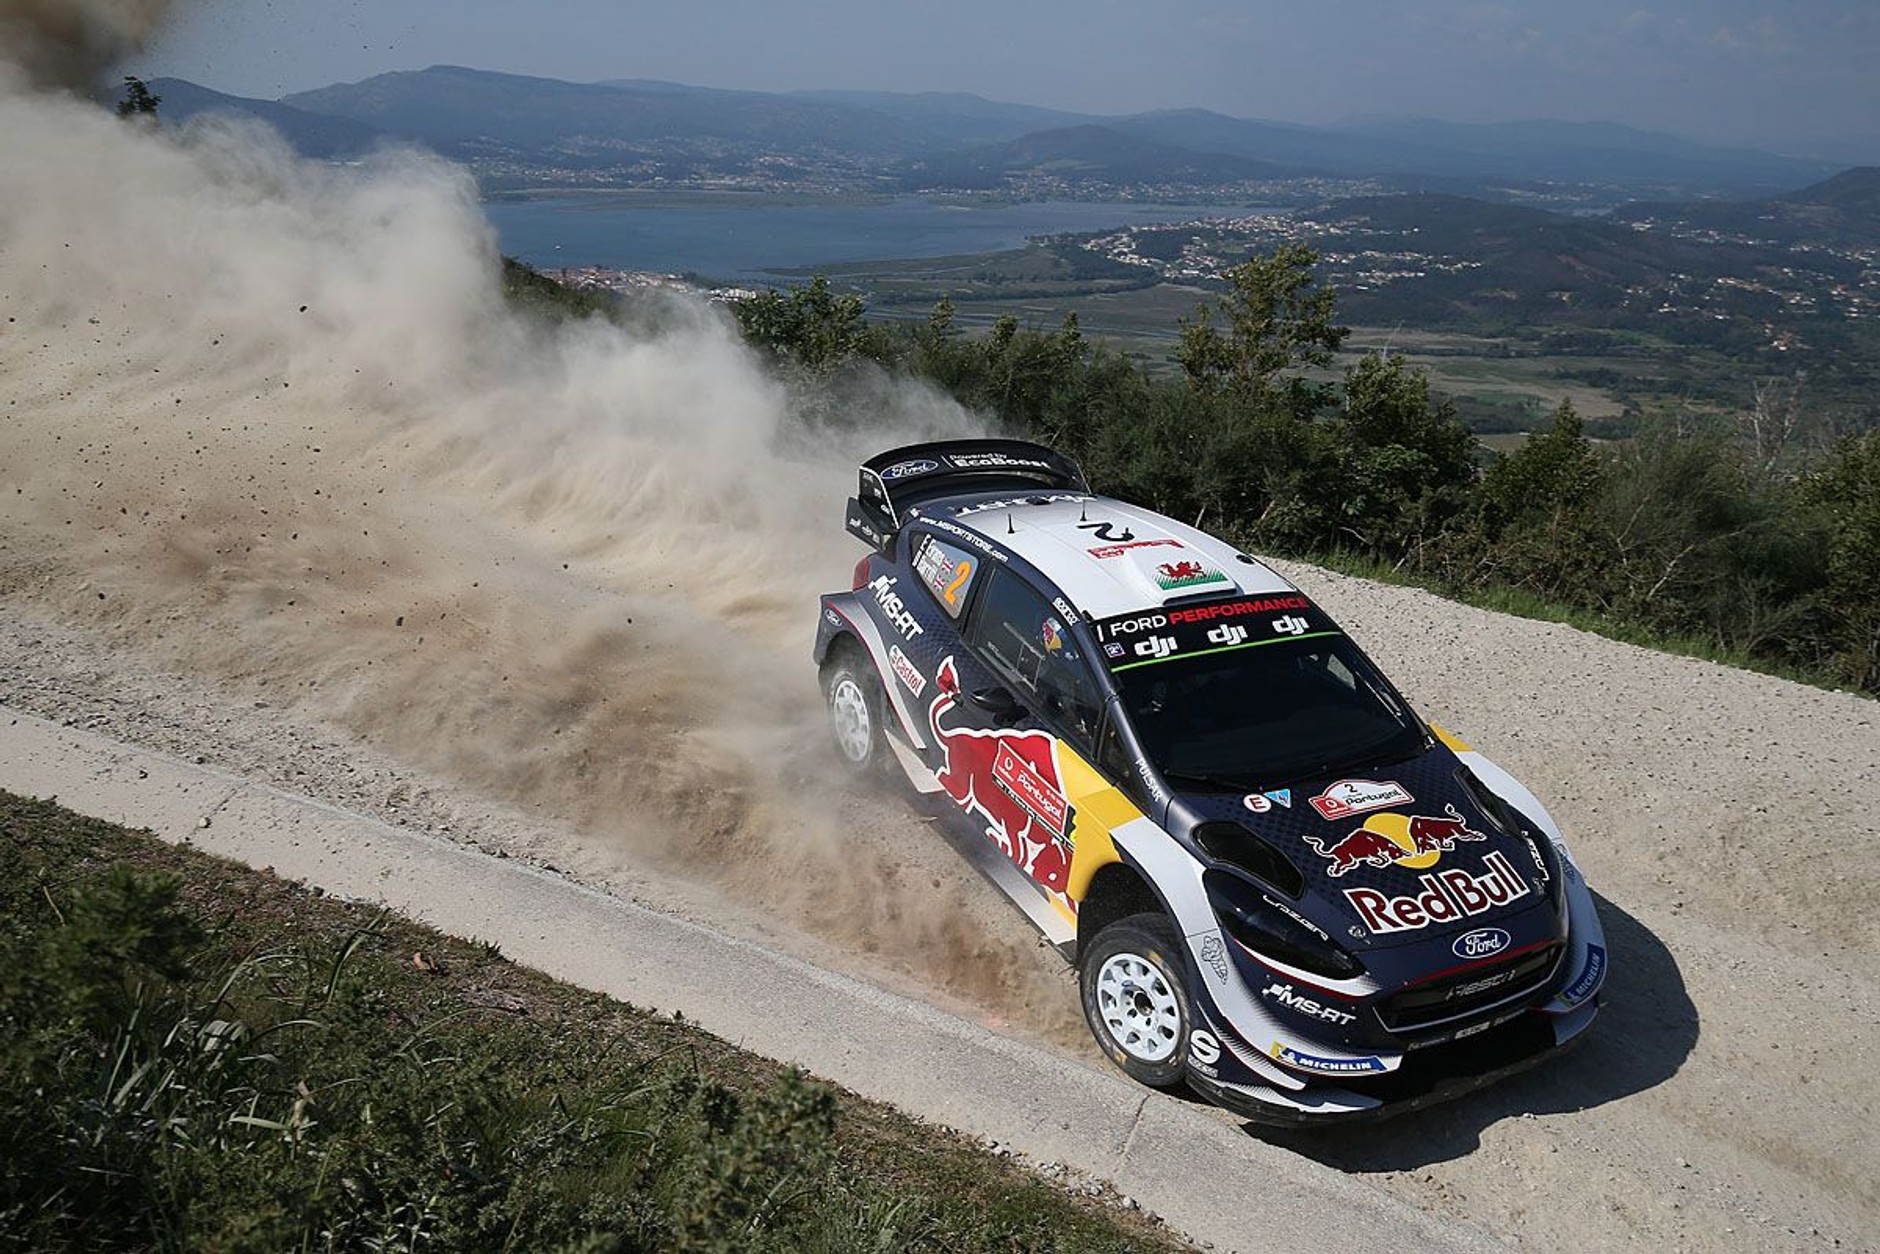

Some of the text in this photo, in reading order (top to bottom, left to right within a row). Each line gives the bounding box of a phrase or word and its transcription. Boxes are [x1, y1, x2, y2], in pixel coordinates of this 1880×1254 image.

[890, 462, 931, 478] Ford
[944, 561, 972, 605] 2
[1109, 597, 1309, 637] FORD PERFORMANCE
[1134, 635, 1178, 658] dji
[1207, 624, 1248, 645] dji
[1271, 614, 1310, 635] dji
[895, 656, 923, 694] Castrol
[1017, 773, 1063, 821] Portugal
[1134, 758, 1165, 802] PULSAR
[1344, 783, 1358, 793] 2
[1345, 788, 1402, 806] Portugal
[1464, 933, 1501, 955] Ford
[1575, 953, 1600, 995] MICHELIN
[1279, 990, 1356, 1026] MS-RT
[1300, 1058, 1372, 1071] MICHELIN
